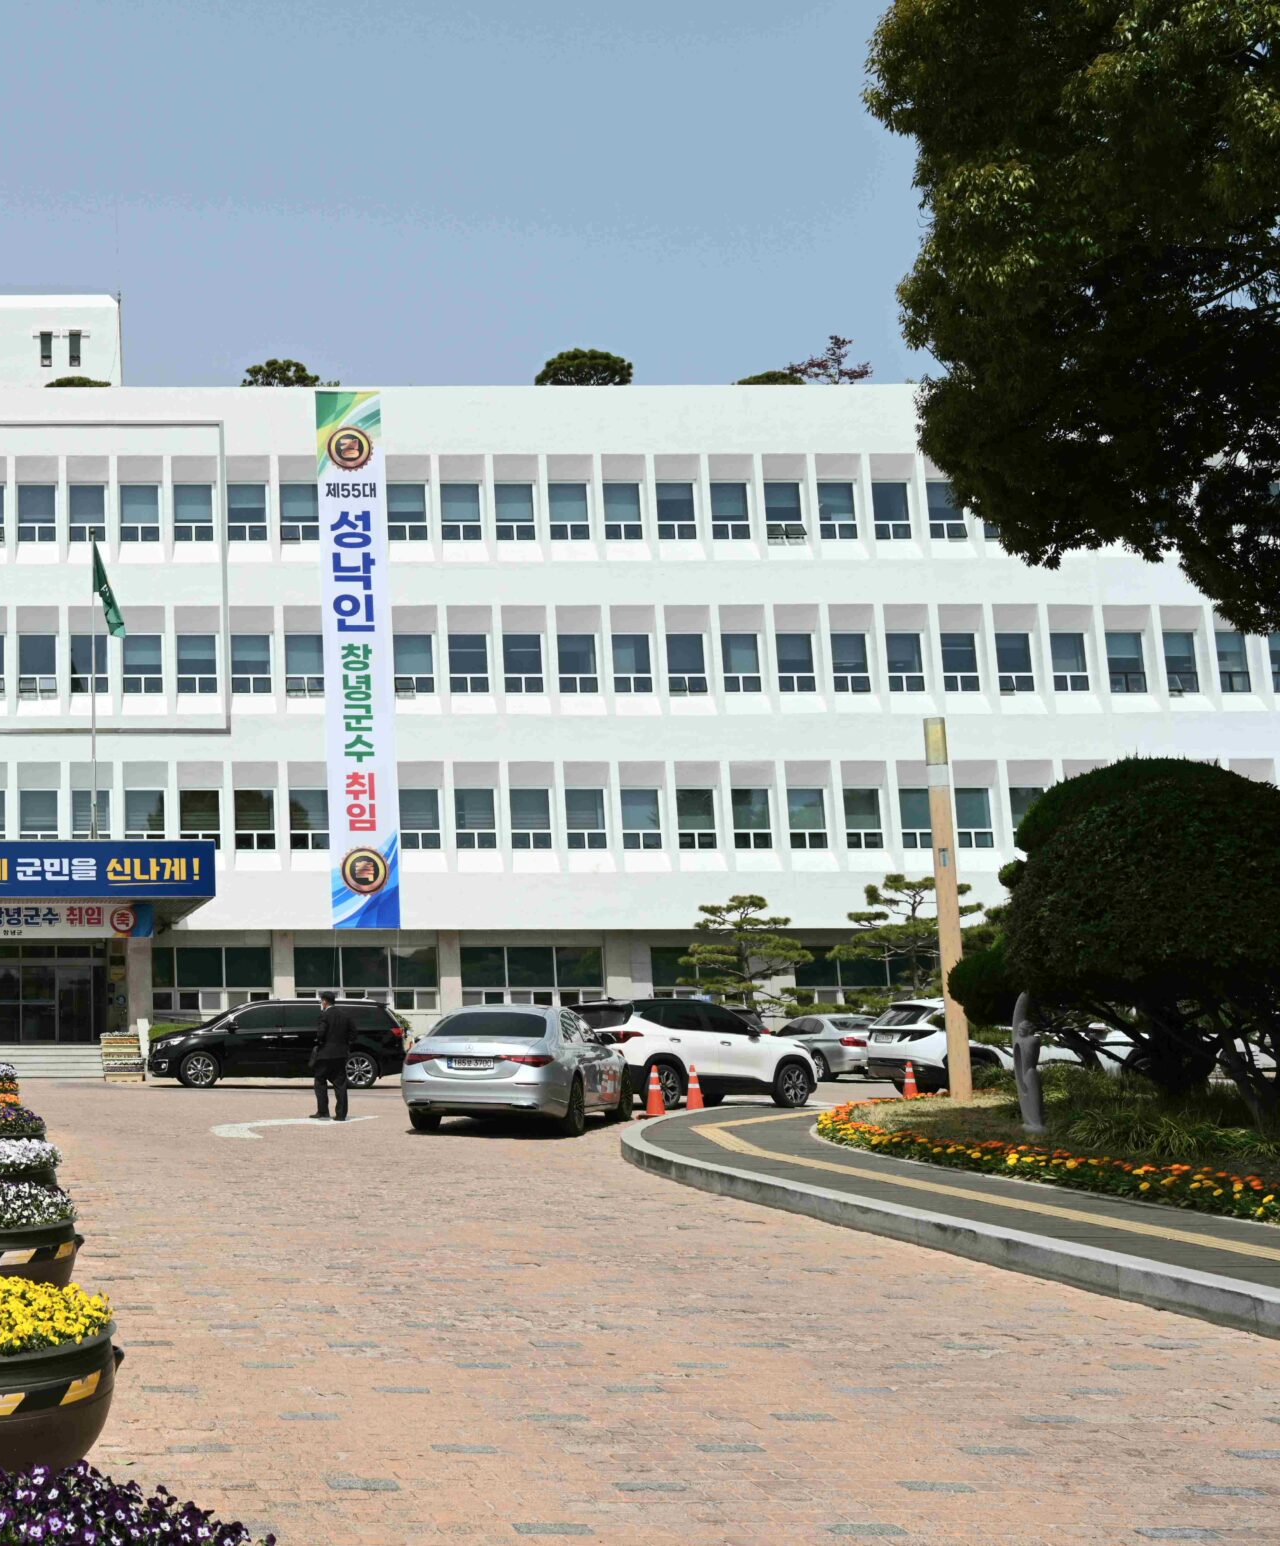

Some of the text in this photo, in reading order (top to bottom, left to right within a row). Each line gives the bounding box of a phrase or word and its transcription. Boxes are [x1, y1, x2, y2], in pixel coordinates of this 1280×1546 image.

[325, 482, 377, 499] 제55대
[330, 510, 377, 832] 성낙인 창녕군수 취임
[16, 857, 98, 881] 군민을
[66, 906, 104, 927] 취임
[116, 911, 130, 928] 축
